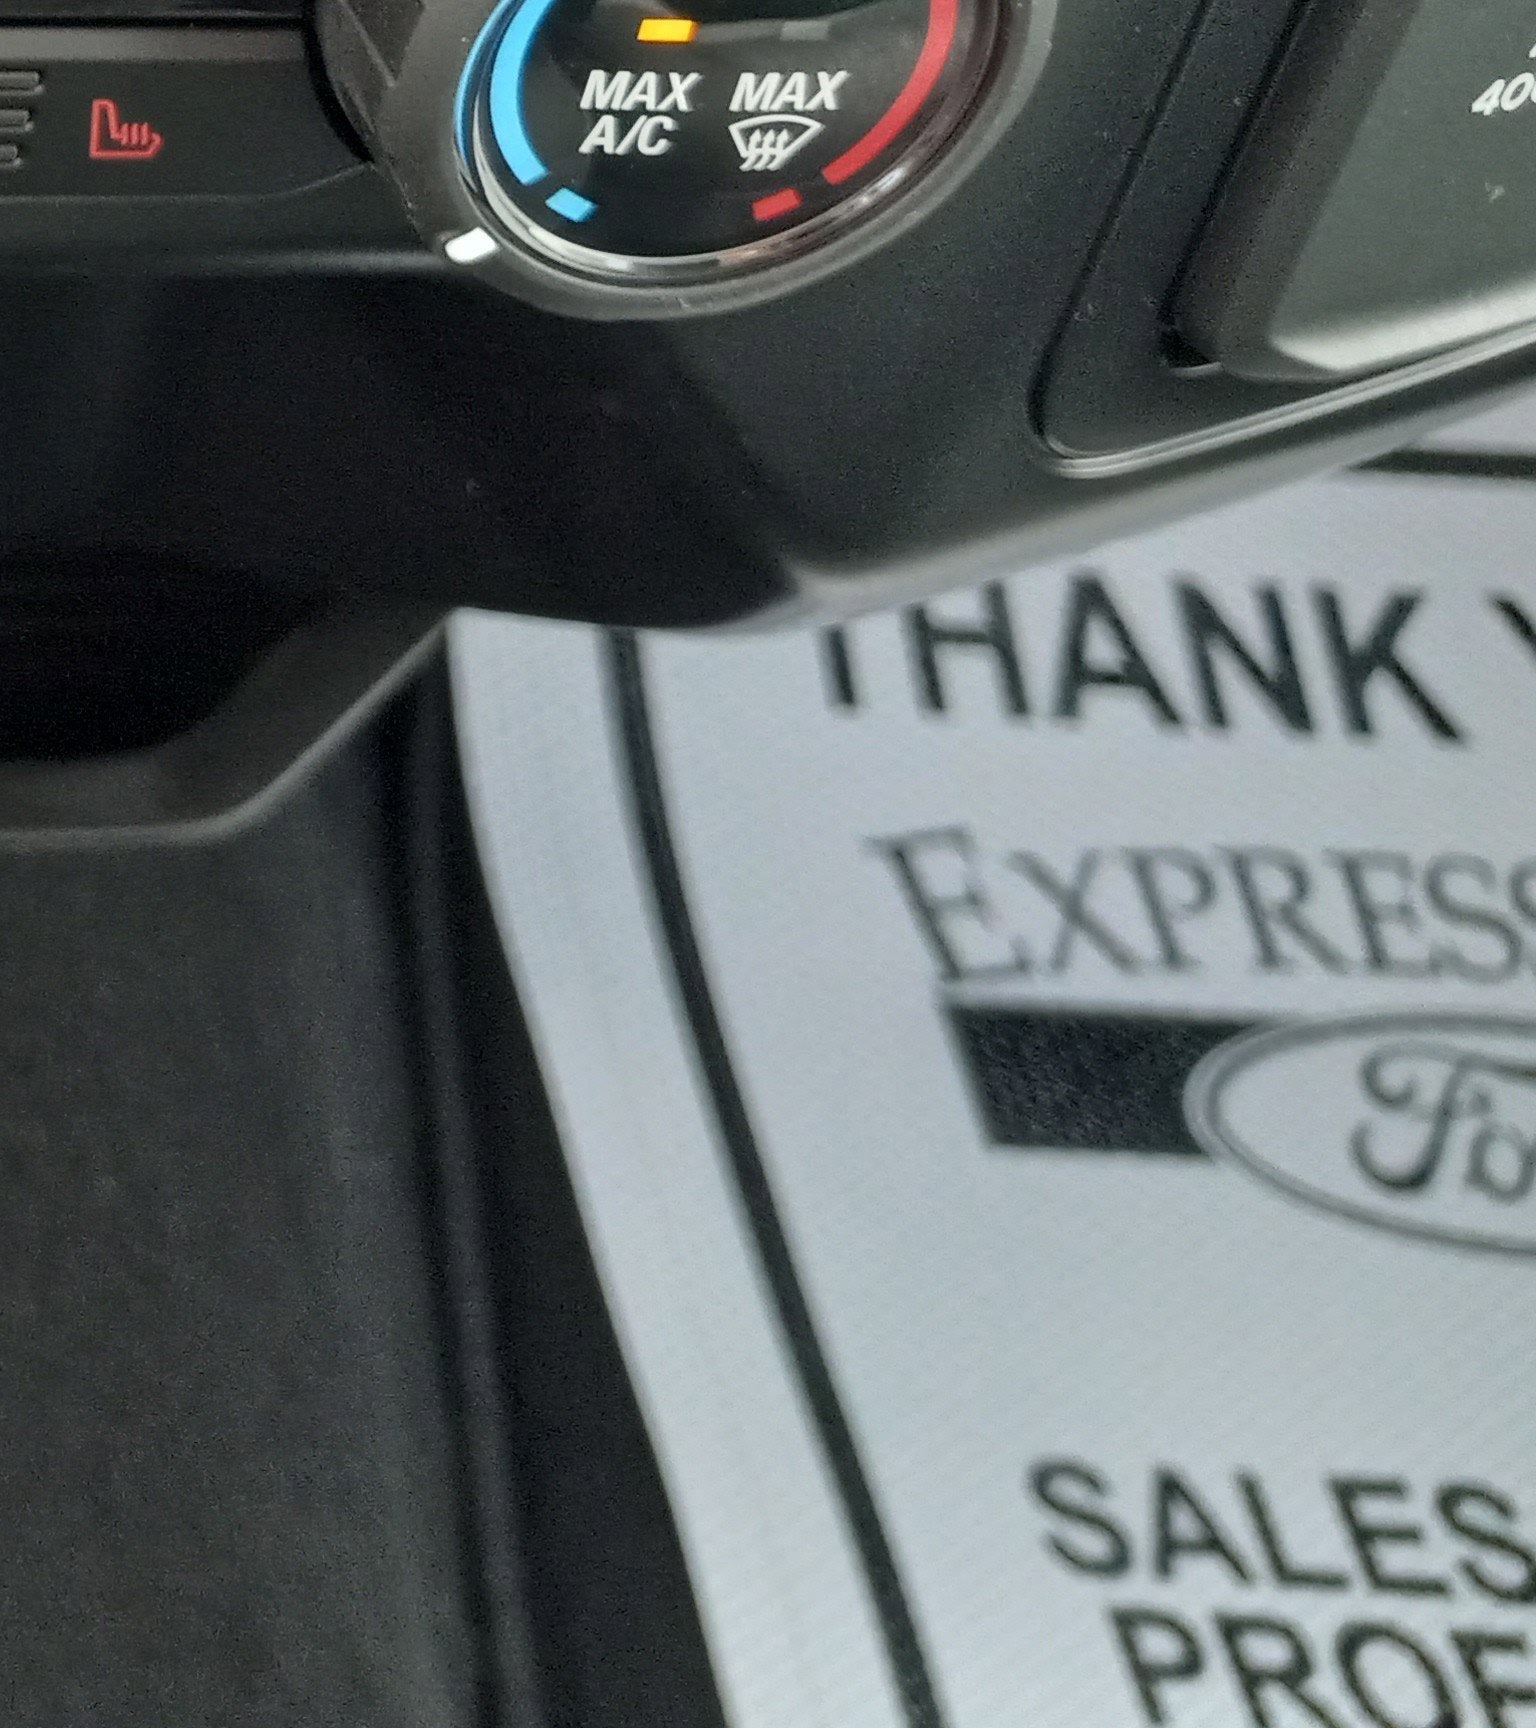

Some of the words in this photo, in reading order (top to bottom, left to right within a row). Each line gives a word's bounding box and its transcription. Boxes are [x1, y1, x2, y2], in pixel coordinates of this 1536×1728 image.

[579, 69, 703, 112] MAX
[729, 70, 851, 112] MAX
[1471, 72, 1536, 116] 40
[578, 114, 679, 156] A/C
[864, 824, 1536, 985] EXPRES
[1029, 1460, 1536, 1605] SALES
